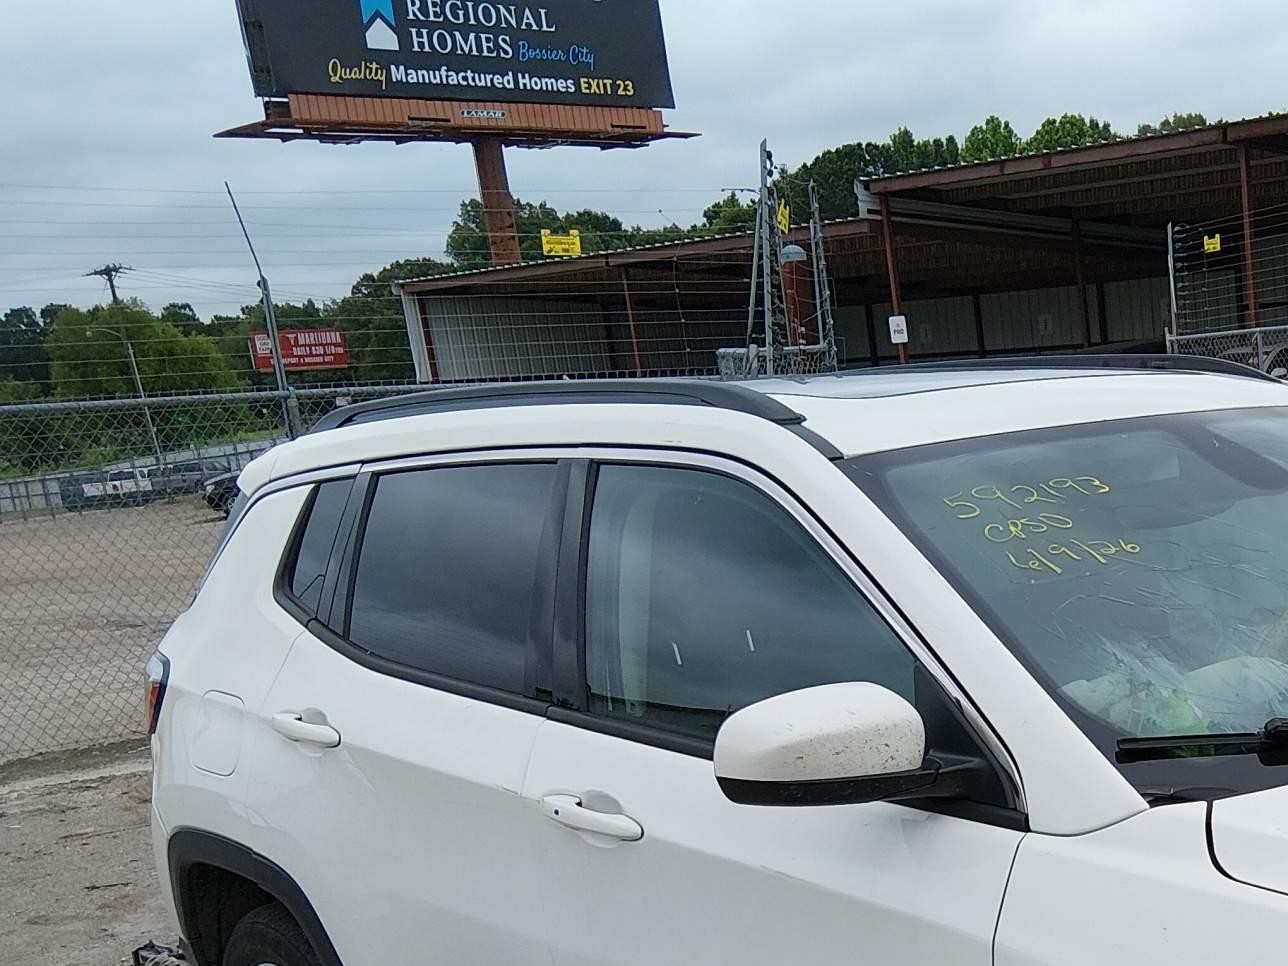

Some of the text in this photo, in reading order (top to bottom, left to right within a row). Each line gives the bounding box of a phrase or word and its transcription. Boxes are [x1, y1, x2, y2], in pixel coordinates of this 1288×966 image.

[407, 0, 556, 32] REGIONAL
[409, 28, 513, 59] HOMES
[518, 41, 595, 71] Bossier City
[328, 58, 634, 96] Quality Manufactured Homes EXIT 23
[943, 476, 1111, 519] 592193
